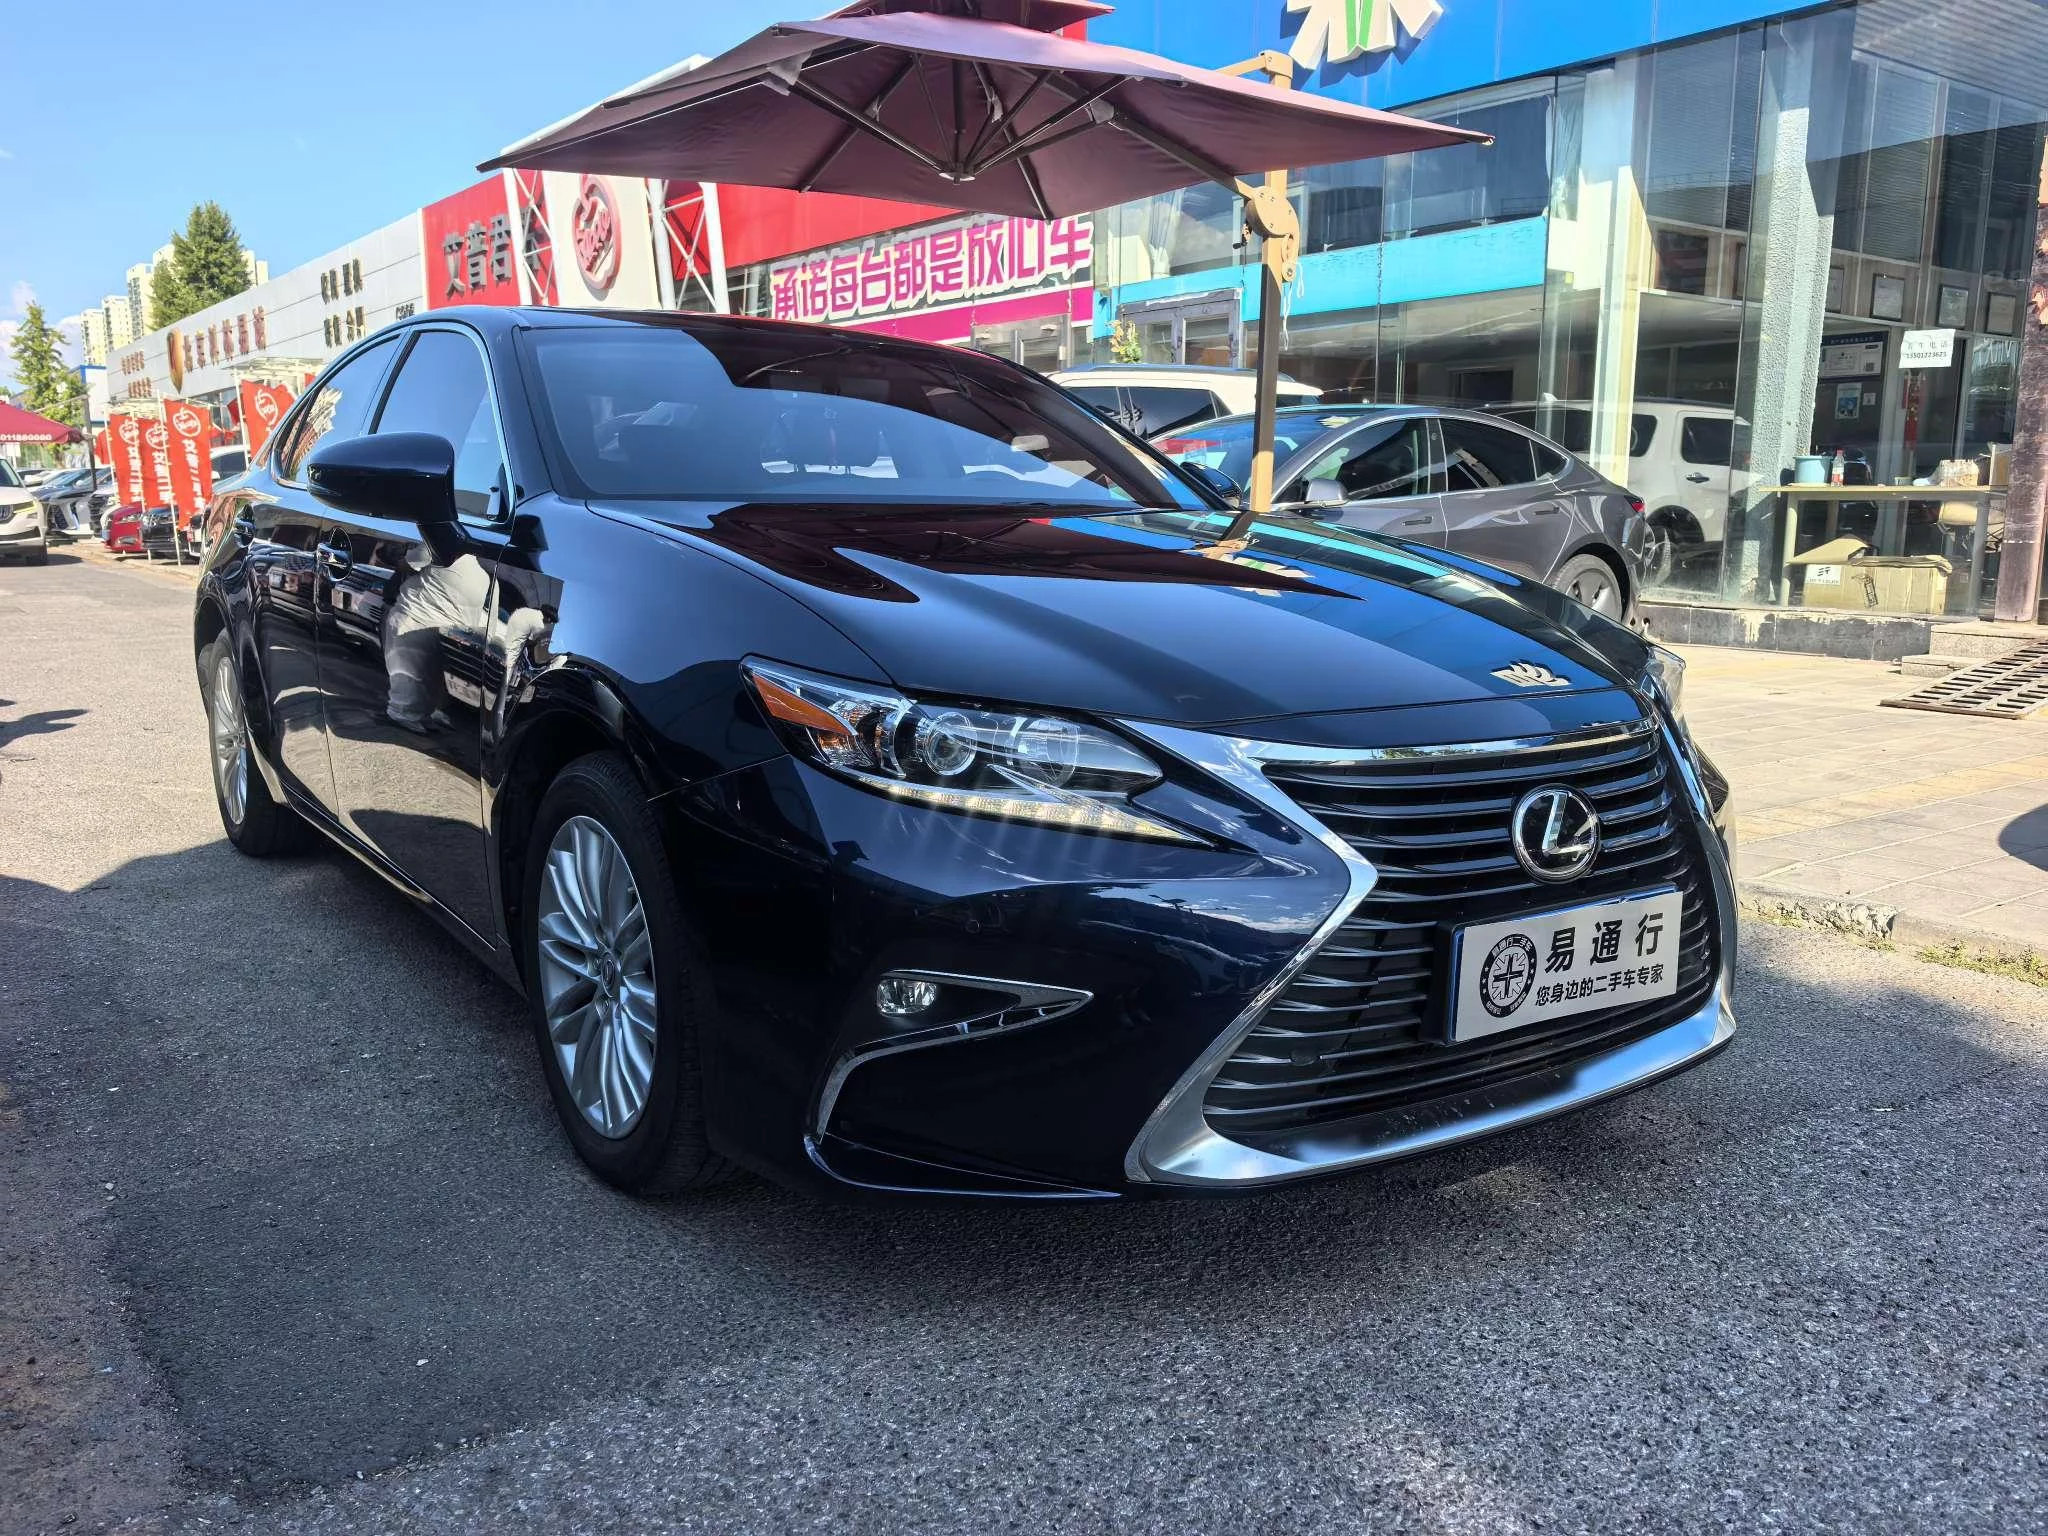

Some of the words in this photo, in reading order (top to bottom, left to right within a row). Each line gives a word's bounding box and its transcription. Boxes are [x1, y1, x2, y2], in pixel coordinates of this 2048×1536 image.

[772, 213, 1090, 320] 承诺每台都是放心车
[1544, 912, 1664, 974] 易通行
[1535, 963, 1664, 1007] 您身边的二手车专家
